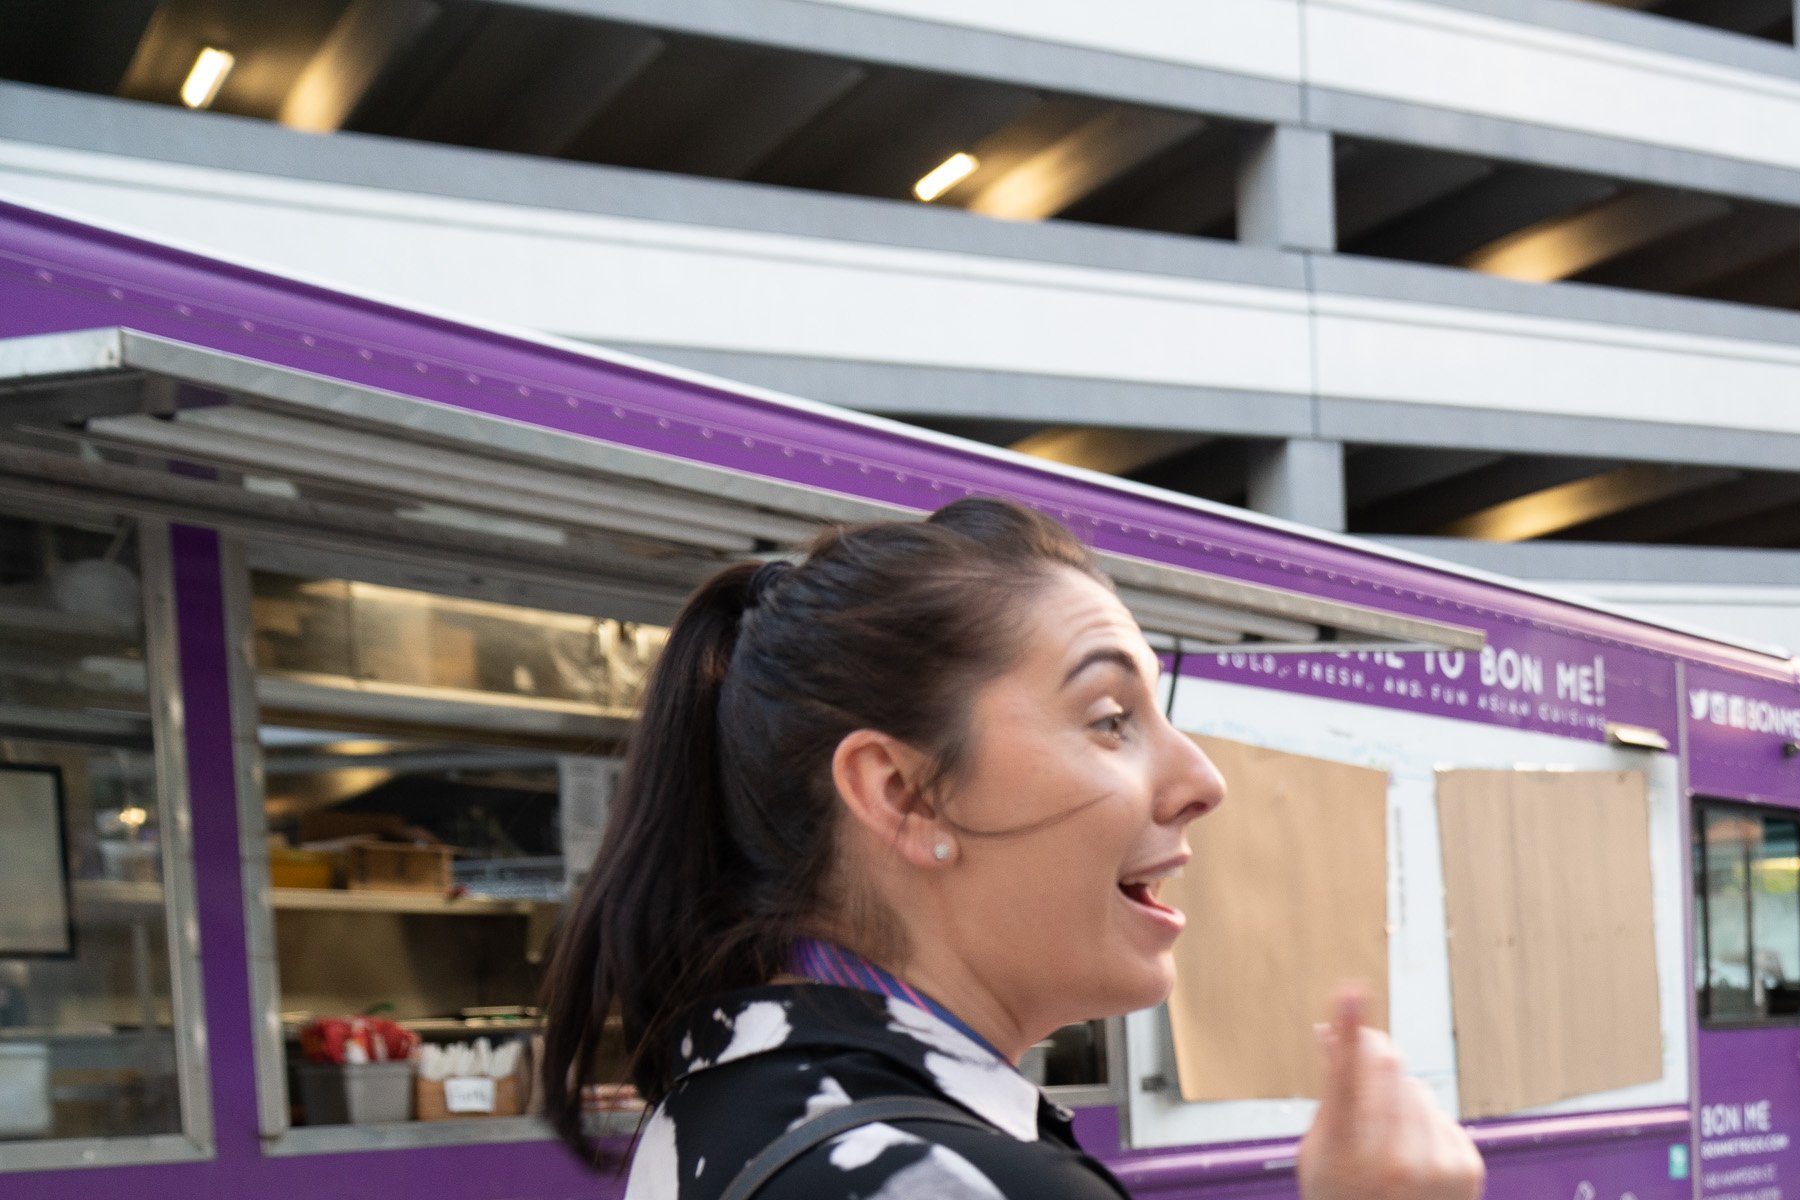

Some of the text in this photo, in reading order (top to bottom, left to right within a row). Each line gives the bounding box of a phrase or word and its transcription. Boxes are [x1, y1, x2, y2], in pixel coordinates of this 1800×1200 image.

[1297, 659, 1377, 693] FRESH,
[1430, 683, 1470, 707] FUN
[1478, 693, 1532, 717] ASIAN
[1480, 644, 1544, 696] BON
[1556, 655, 1606, 708] ME!
[1701, 1100, 1771, 1138] BON ME
